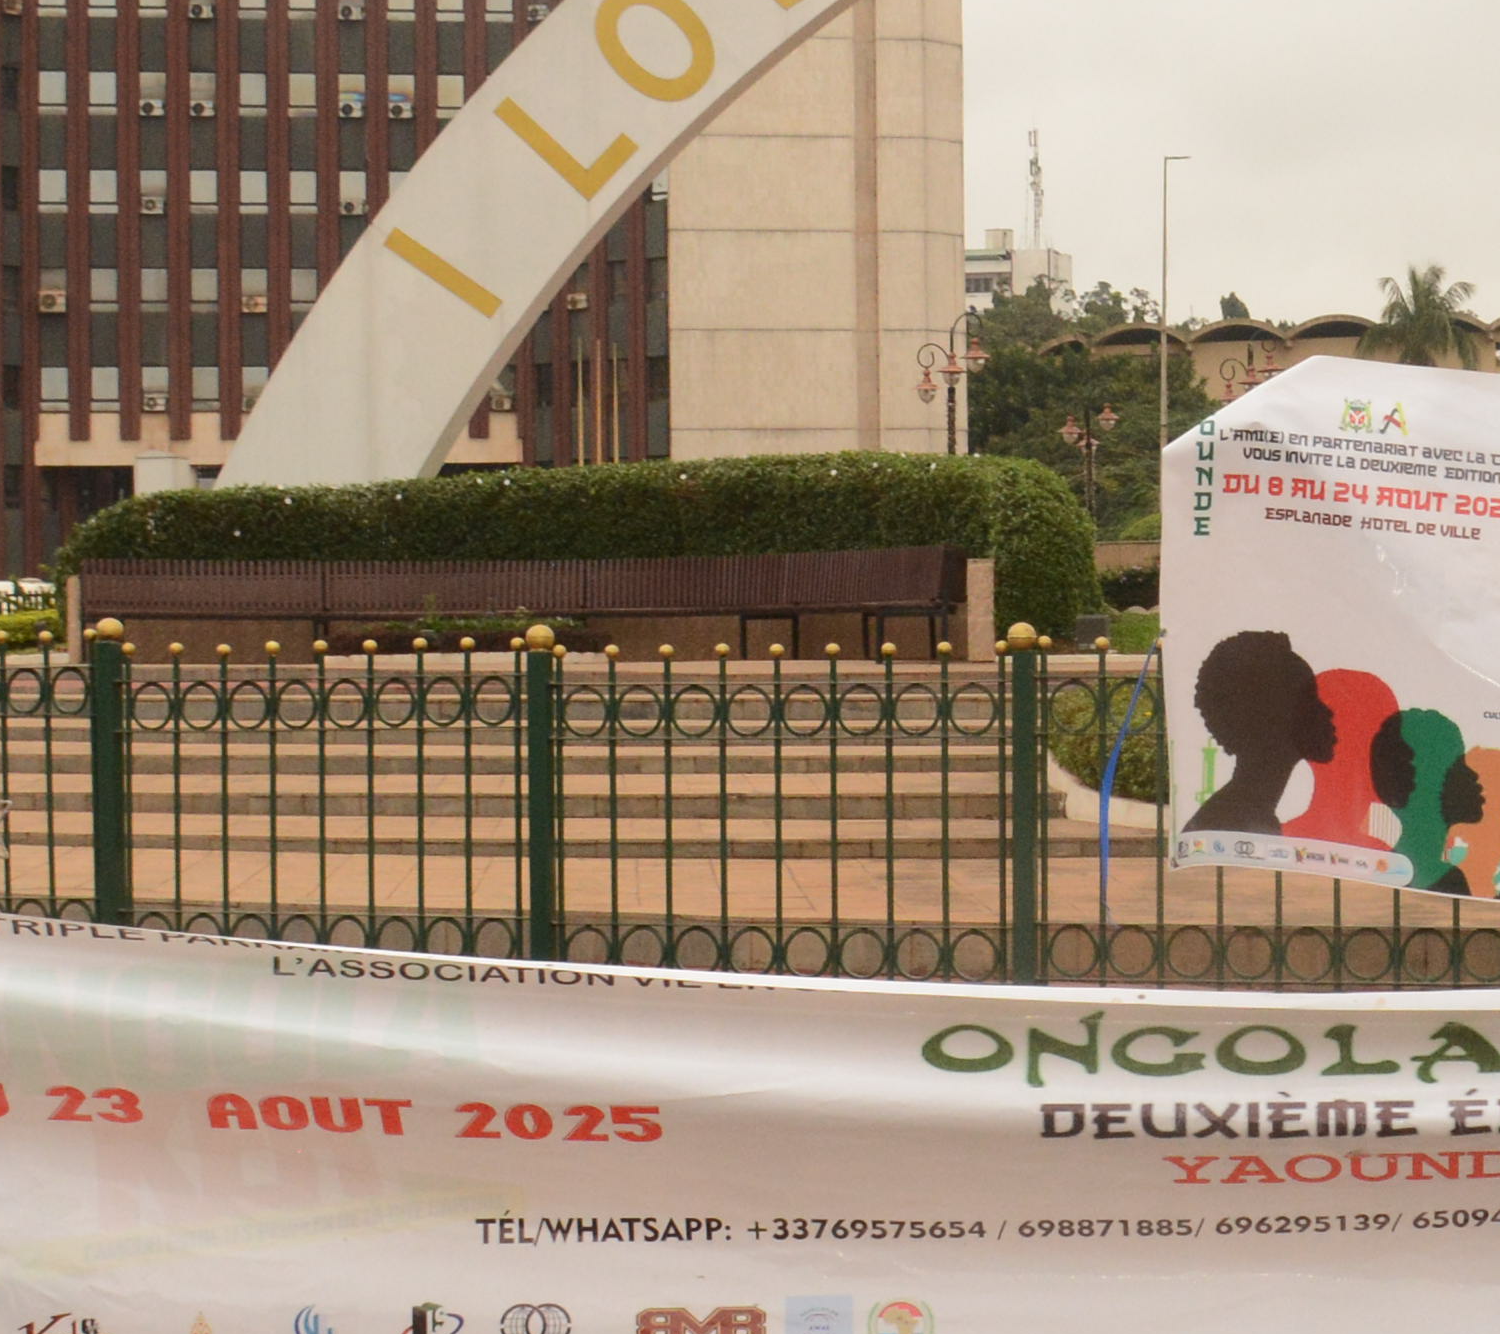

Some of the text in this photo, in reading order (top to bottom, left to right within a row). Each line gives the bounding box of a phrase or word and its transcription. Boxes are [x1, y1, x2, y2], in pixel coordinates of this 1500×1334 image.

[384, 227, 502, 318] I
[1243, 447, 1281, 461] VOUS
[1285, 451, 1333, 467] INVITE
[1223, 474, 1260, 494] DU
[1268, 476, 1283, 496] 8
[1291, 478, 1326, 501] AU
[1333, 482, 1368, 504] 24
[1376, 486, 1447, 512] AOUT
[1265, 508, 1481, 540] ESPLANADE HOTEL DE VILLE
[44, 1086, 146, 1125] 23
[208, 1092, 413, 1136] AOUT
[453, 1101, 665, 1145] 2025
[1039, 1091, 1419, 1141] DEUXIÈME
[475, 1212, 732, 1248] TÉL/WHATSAPP:
[747, 1218, 987, 1242] +33769575654
[1017, 1216, 1203, 1241] 698871885/
[1215, 1211, 1403, 1237] 696295139/
